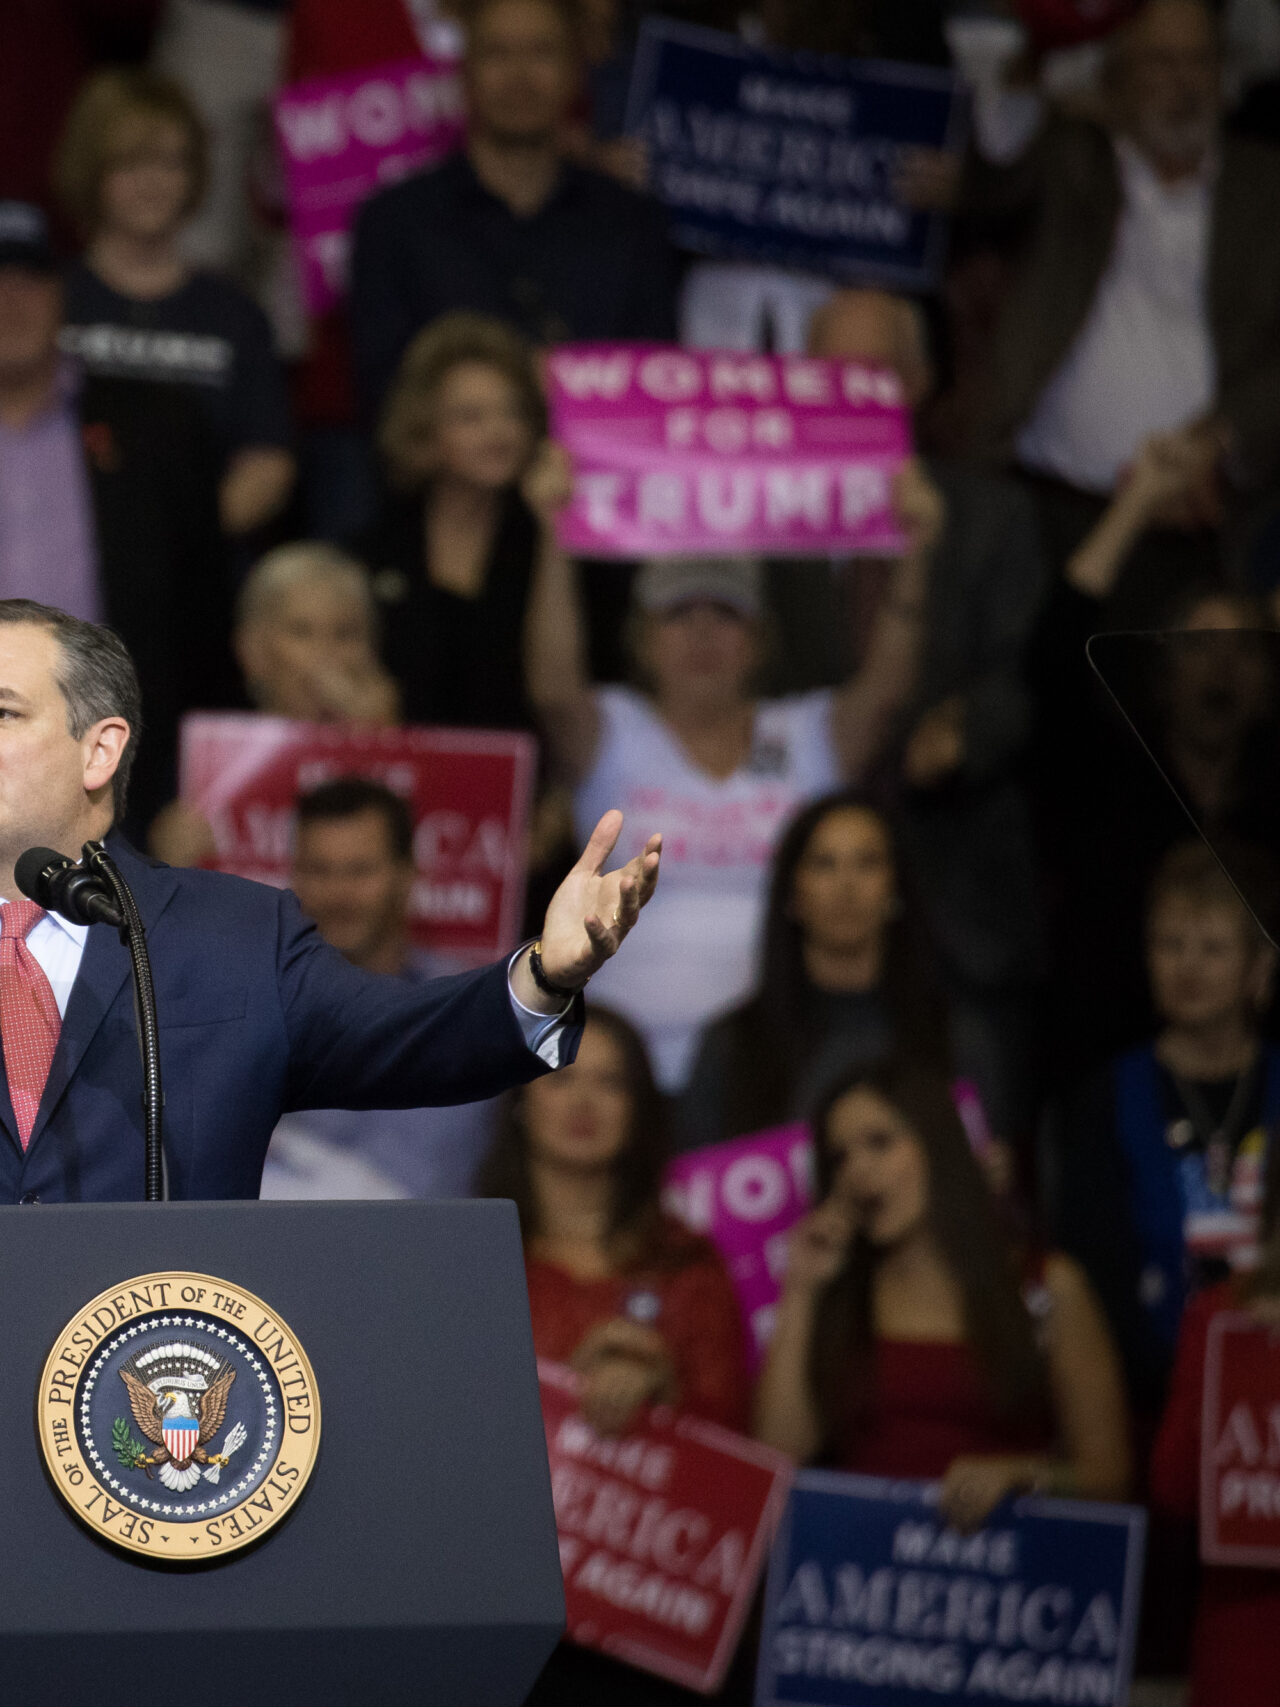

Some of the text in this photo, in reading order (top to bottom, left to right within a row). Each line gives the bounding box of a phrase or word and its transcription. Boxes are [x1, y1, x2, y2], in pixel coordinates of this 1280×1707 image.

[276, 71, 468, 162] WOM
[654, 98, 904, 194] AMERIC
[553, 350, 904, 408] WOMEN
[666, 406, 794, 453] FOR
[580, 467, 890, 534] TRUMP
[48, 1283, 311, 1546] SEAL OF THE PRESIDENT OF THE UNITED STATES
[551, 1466, 746, 1596] ERICA
[892, 1520, 1016, 1576] MAKE
[574, 1551, 712, 1636] AGAIN
[778, 1560, 1118, 1656] AMERICA
[774, 1624, 1116, 1702] STRONG AGAIN
